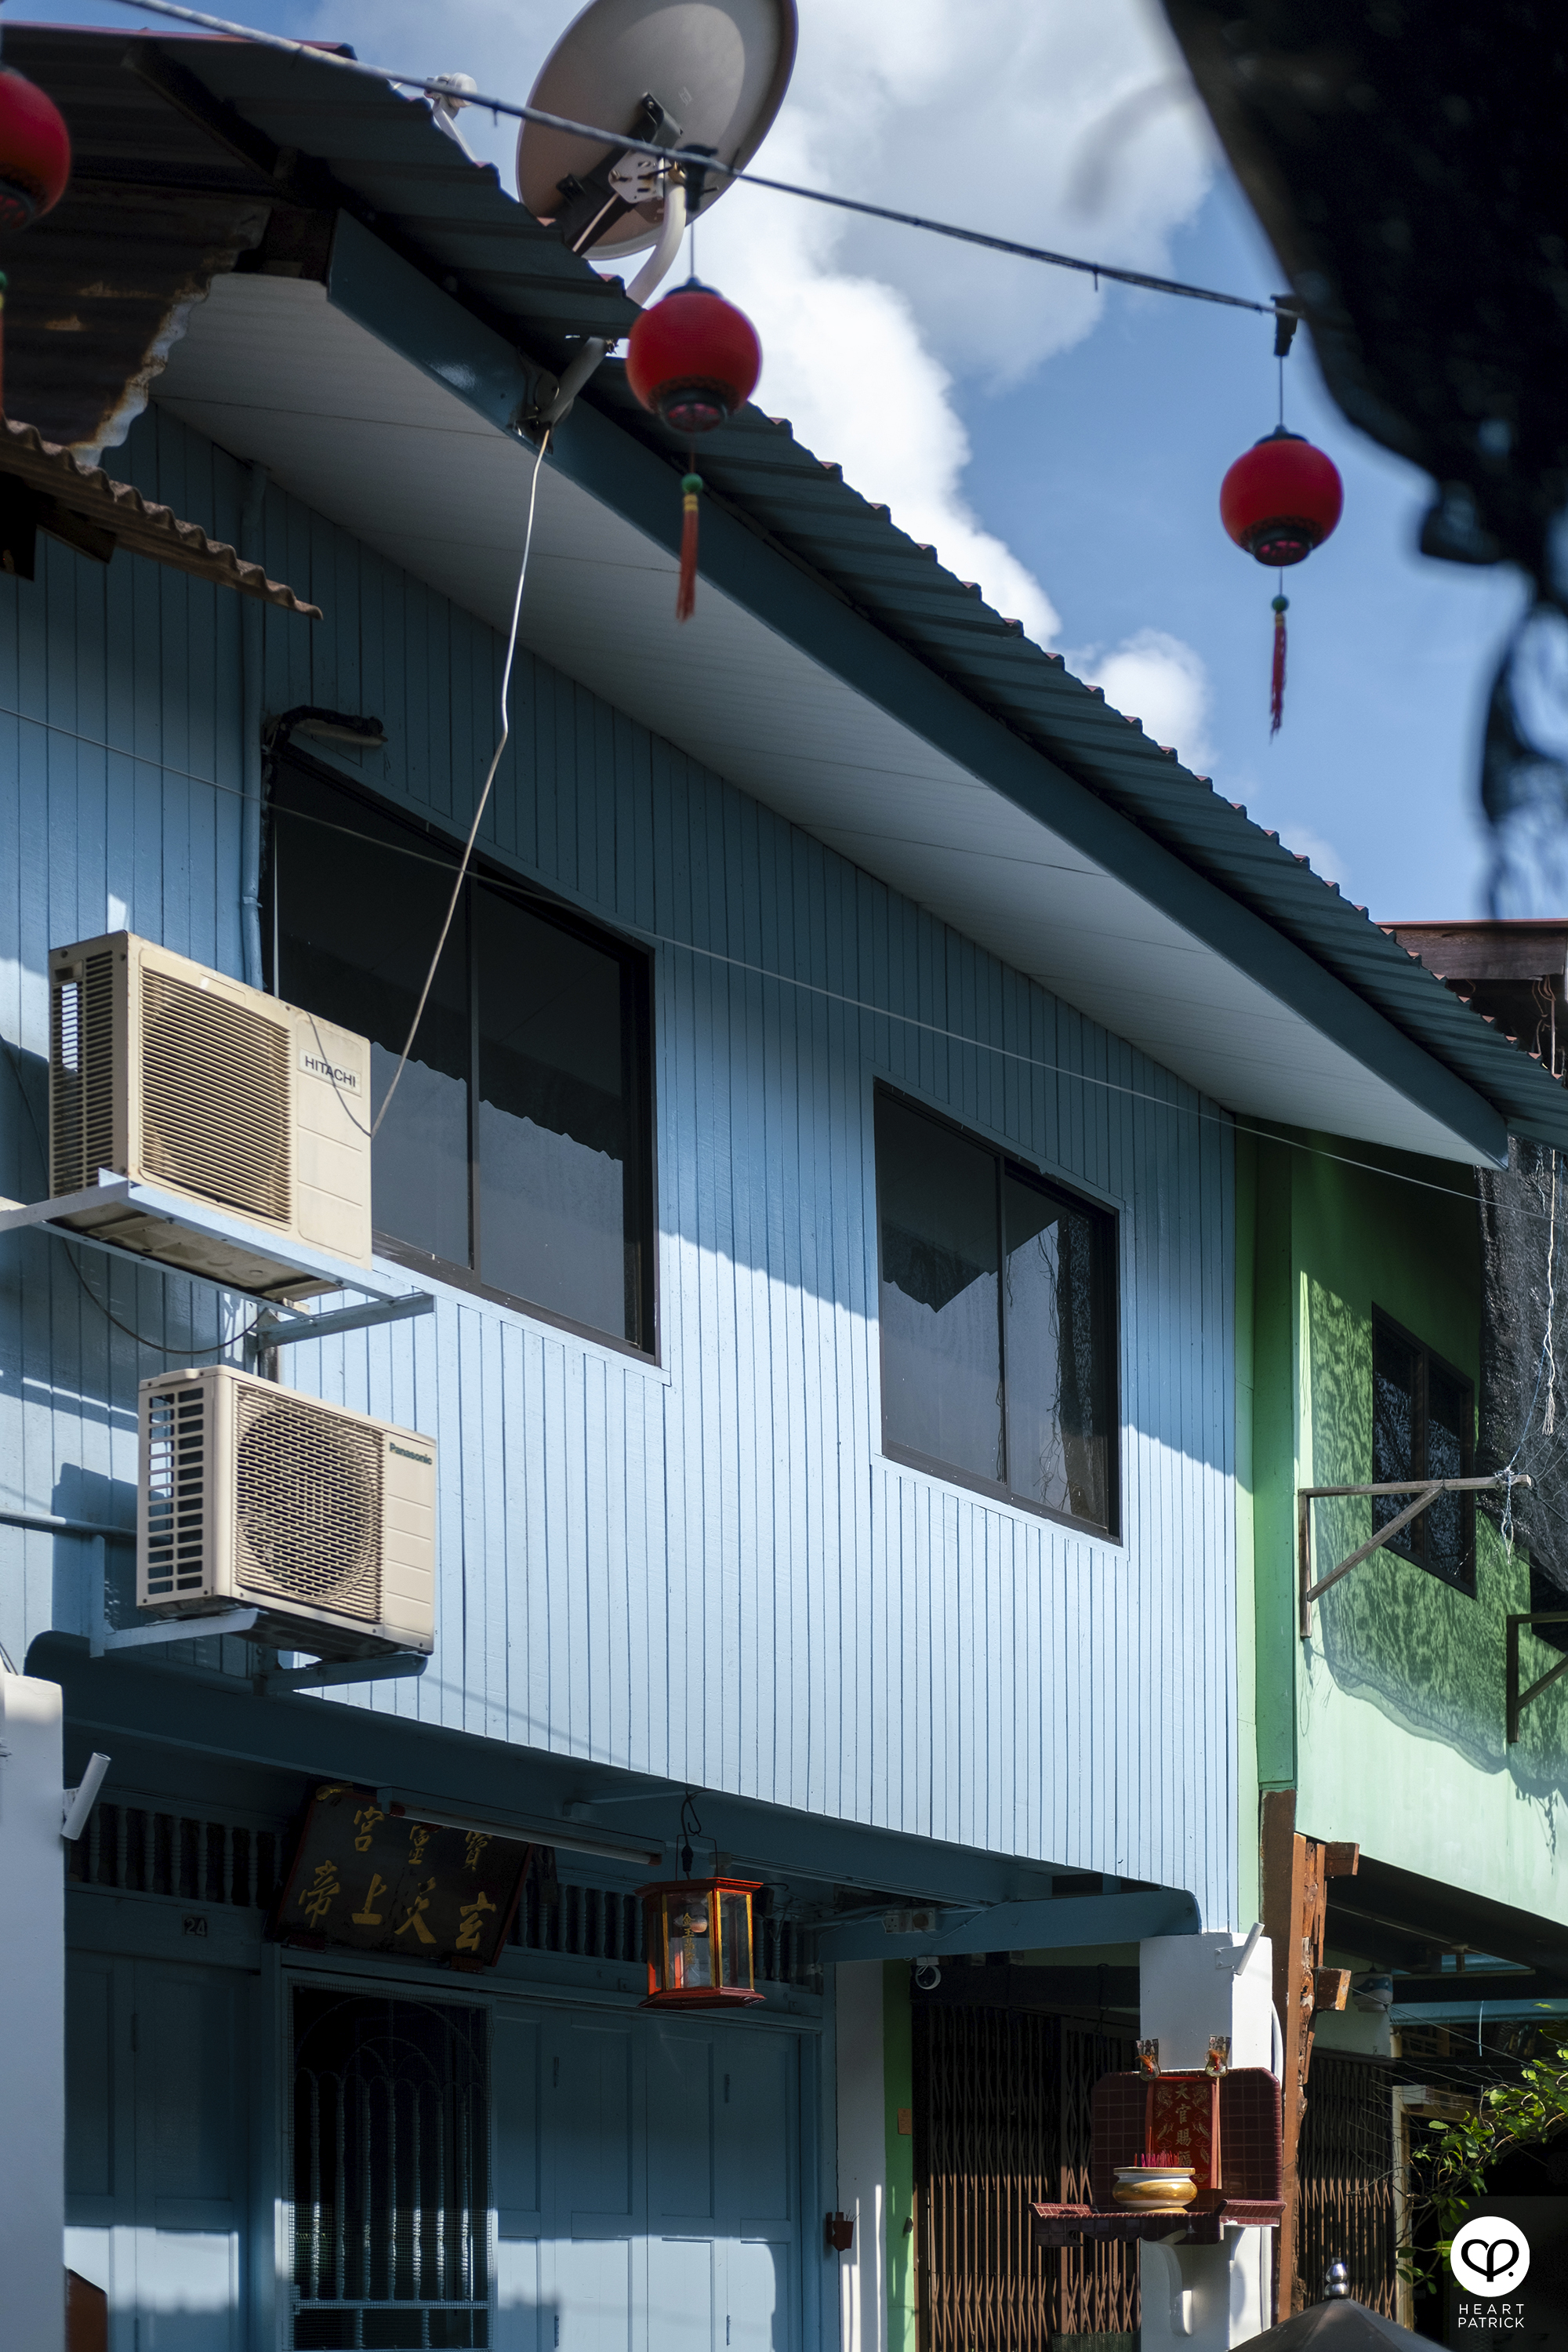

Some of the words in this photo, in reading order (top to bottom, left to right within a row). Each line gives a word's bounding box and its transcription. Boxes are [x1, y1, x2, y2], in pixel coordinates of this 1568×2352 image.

[305, 1055, 356, 1087] HITACHI
[390, 1442, 433, 1465] Panasonic
[185, 1916, 207, 1936] 24
[1175, 2082, 1192, 2167] 天官賜福
